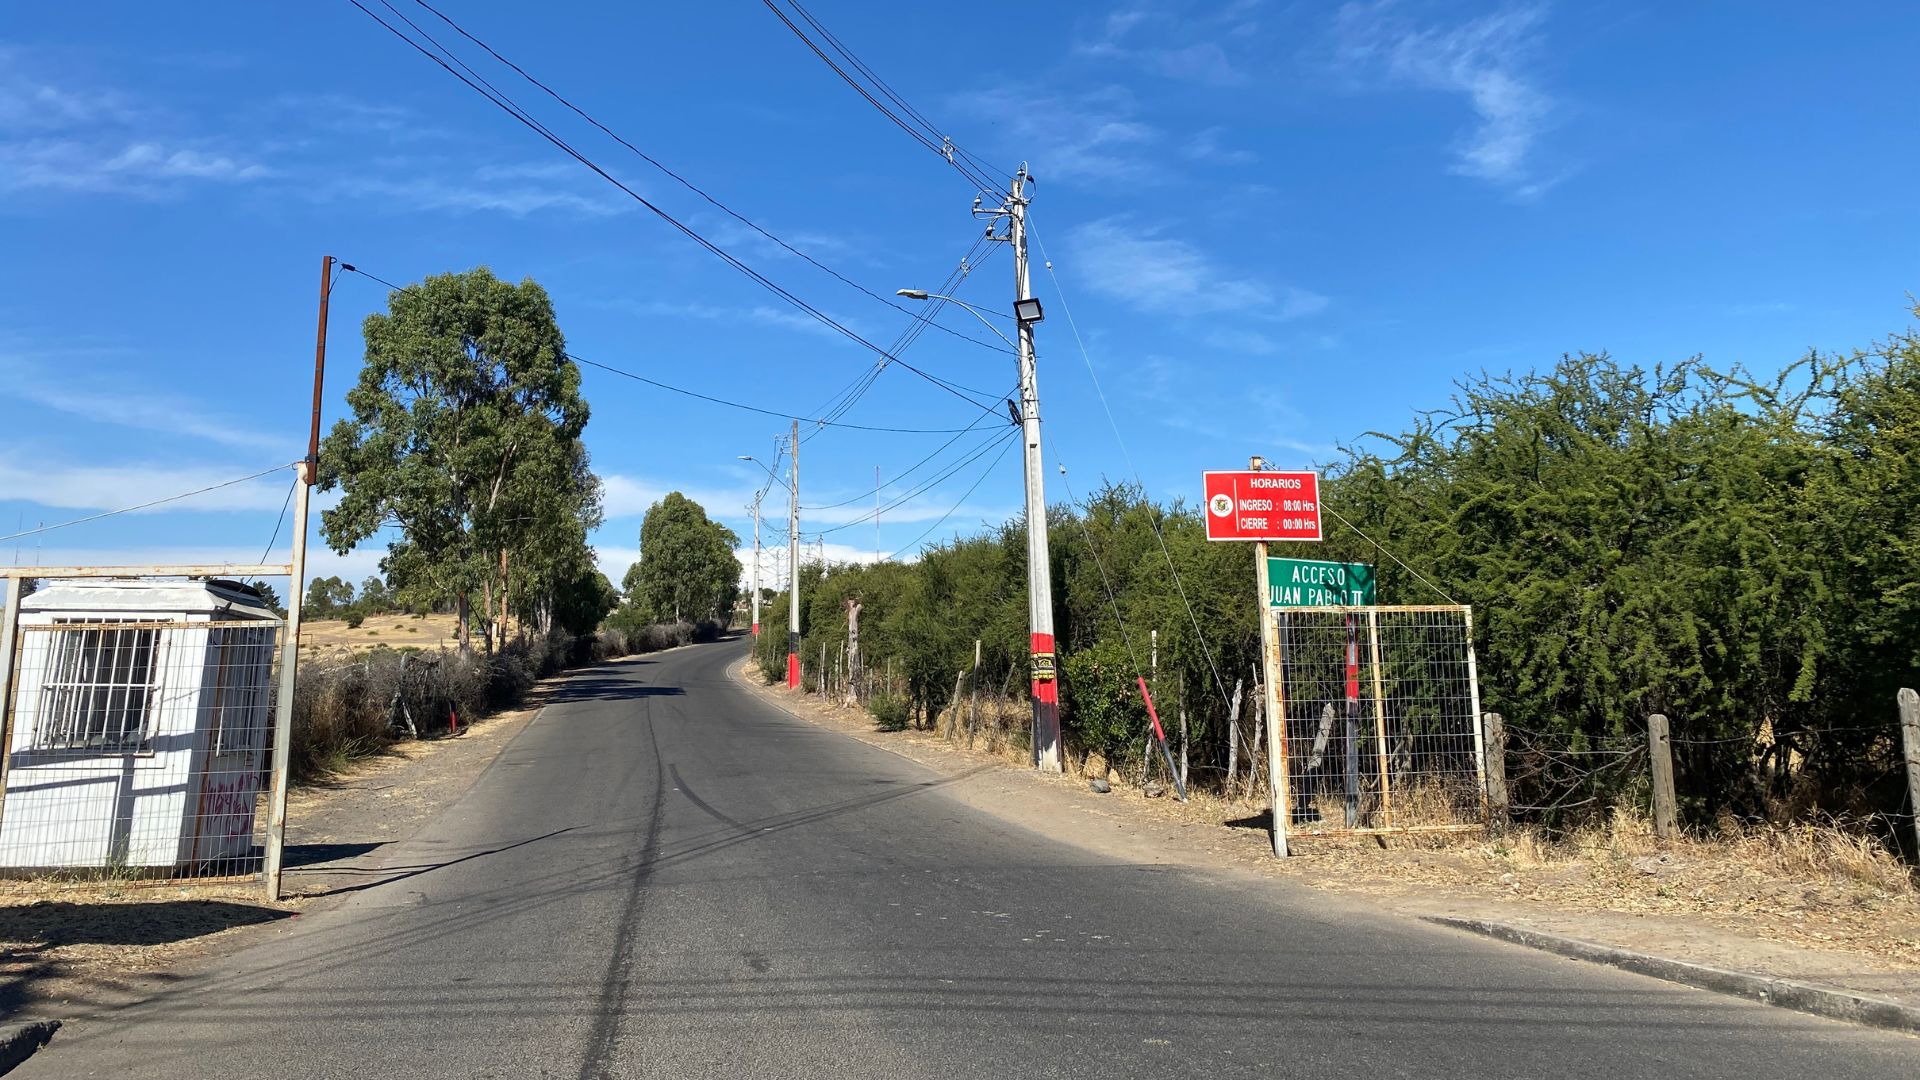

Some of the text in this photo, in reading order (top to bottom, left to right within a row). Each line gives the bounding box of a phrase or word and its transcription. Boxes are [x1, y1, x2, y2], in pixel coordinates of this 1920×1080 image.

[1250, 478, 1301, 489] HORARIOS
[1240, 499, 1273, 511] INGRESO
[1283, 500, 1301, 511] 08:00
[1302, 500, 1315, 511] Hrs
[1240, 518, 1268, 529] CIERRE
[1283, 518, 1302, 530] 00:00
[1304, 518, 1316, 530] Hrs
[1292, 565, 1346, 586] ACCESO
[1269, 585, 1301, 605] JUAN
[1308, 588, 1348, 606] PABLO
